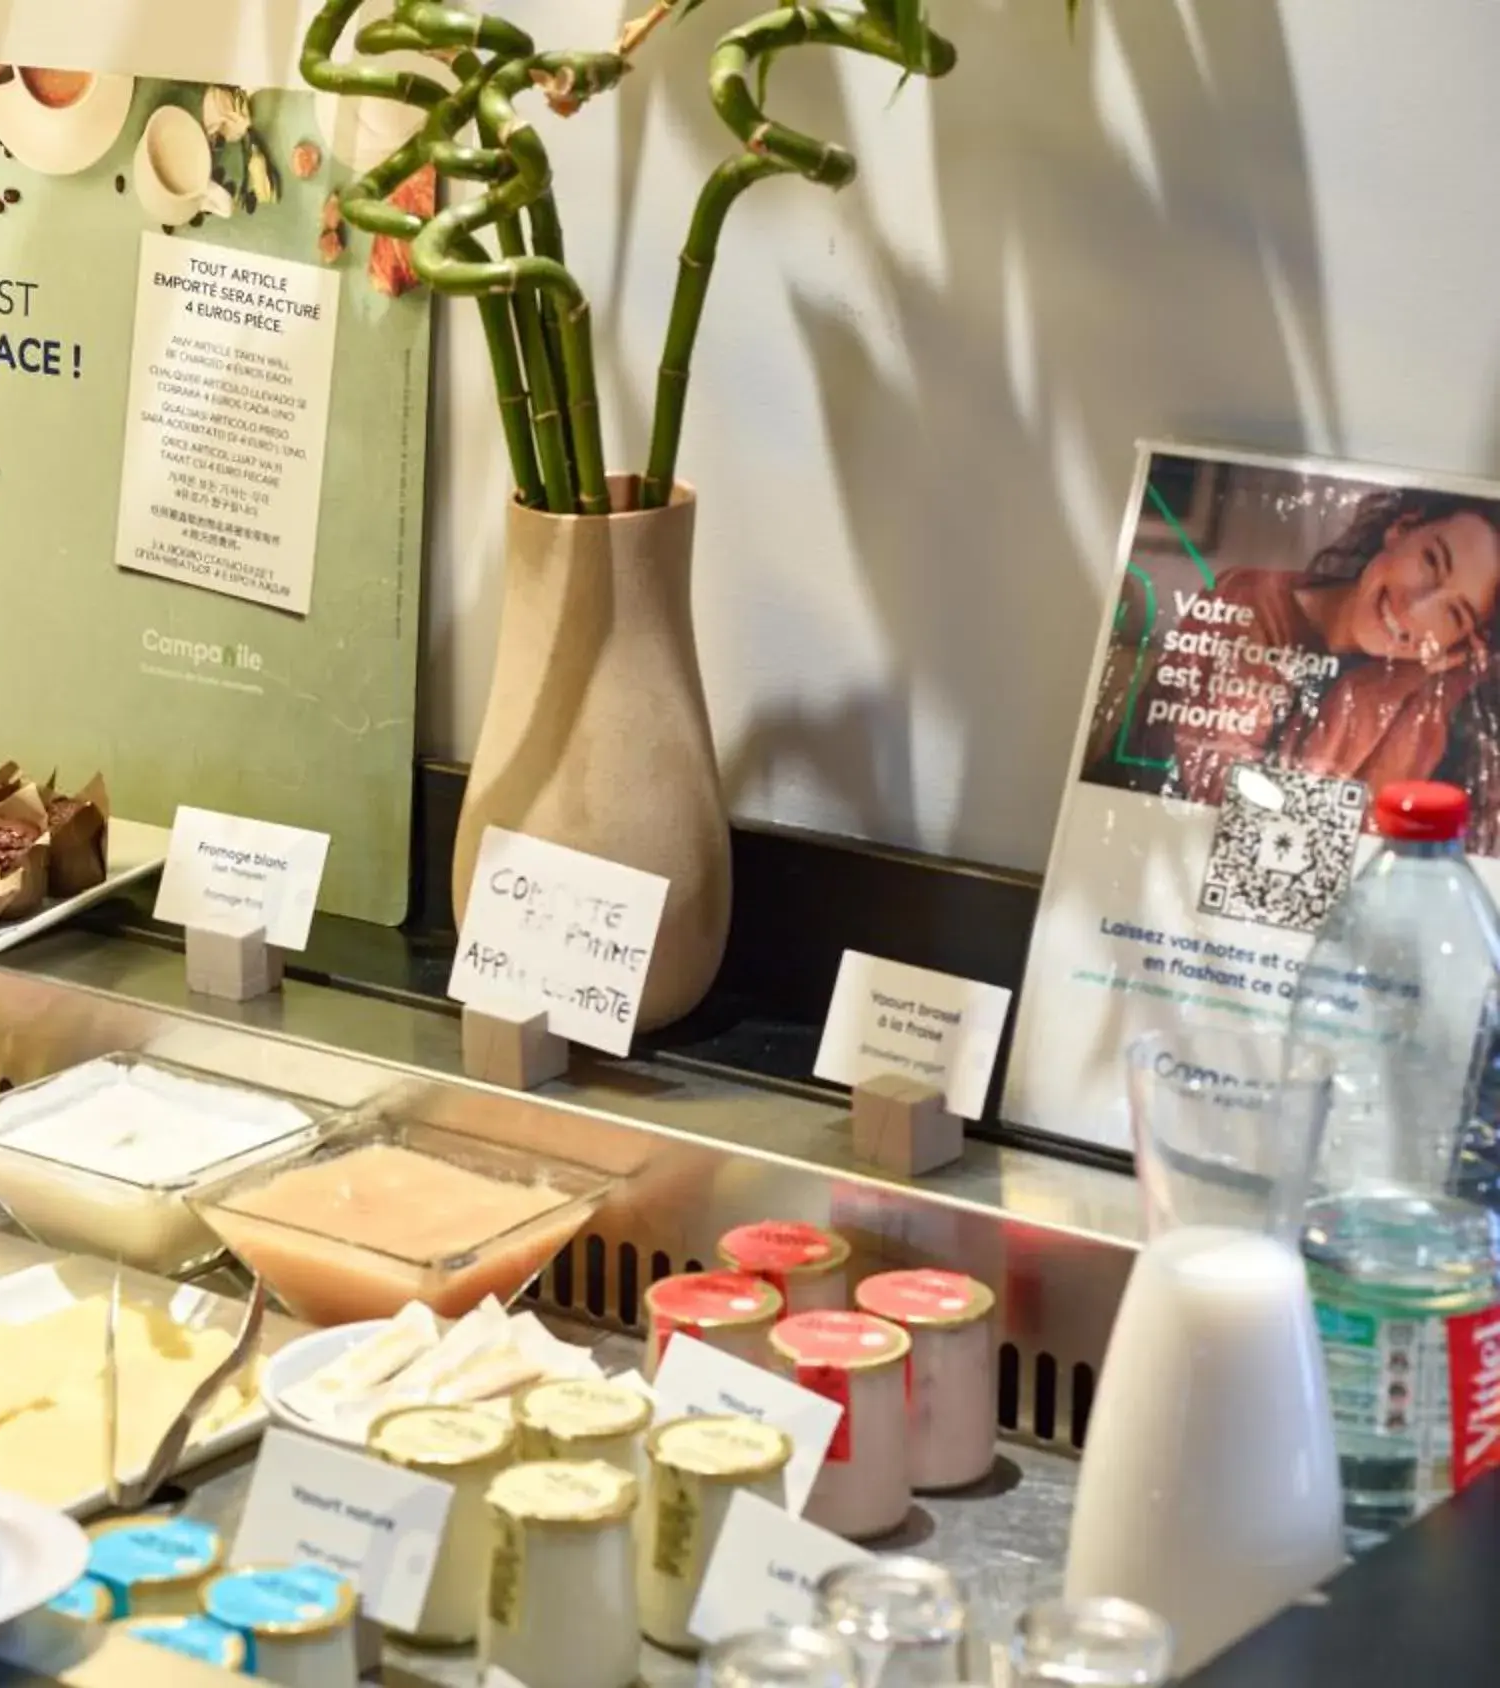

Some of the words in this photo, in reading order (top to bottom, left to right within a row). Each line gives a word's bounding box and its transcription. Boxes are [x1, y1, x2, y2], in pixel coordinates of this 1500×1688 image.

[190, 258, 226, 280] TOUT
[231, 266, 287, 292] ARTICLE
[153, 272, 217, 299] EMPORTÉ
[219, 287, 254, 306] SERA
[258, 293, 321, 320] FACTURÉ
[185, 301, 194, 316] 4
[197, 303, 241, 324] EUROS
[1173, 590, 1254, 626] Votre
[142, 628, 263, 671] Campanile
[1164, 630, 1340, 678] satisfaction
[1157, 664, 1202, 690] est
[1208, 672, 1288, 702] notre
[1147, 698, 1256, 735] priorité
[198, 842, 250, 864] Fromage
[254, 852, 288, 871] blanc
[1100, 918, 1164, 945] Laissez
[1170, 934, 1201, 951] vos
[1204, 940, 1256, 965] notes
[1260, 950, 1279, 968] et
[1143, 956, 1166, 973] en
[1169, 956, 1246, 990] flashant
[1250, 978, 1273, 995] ce
